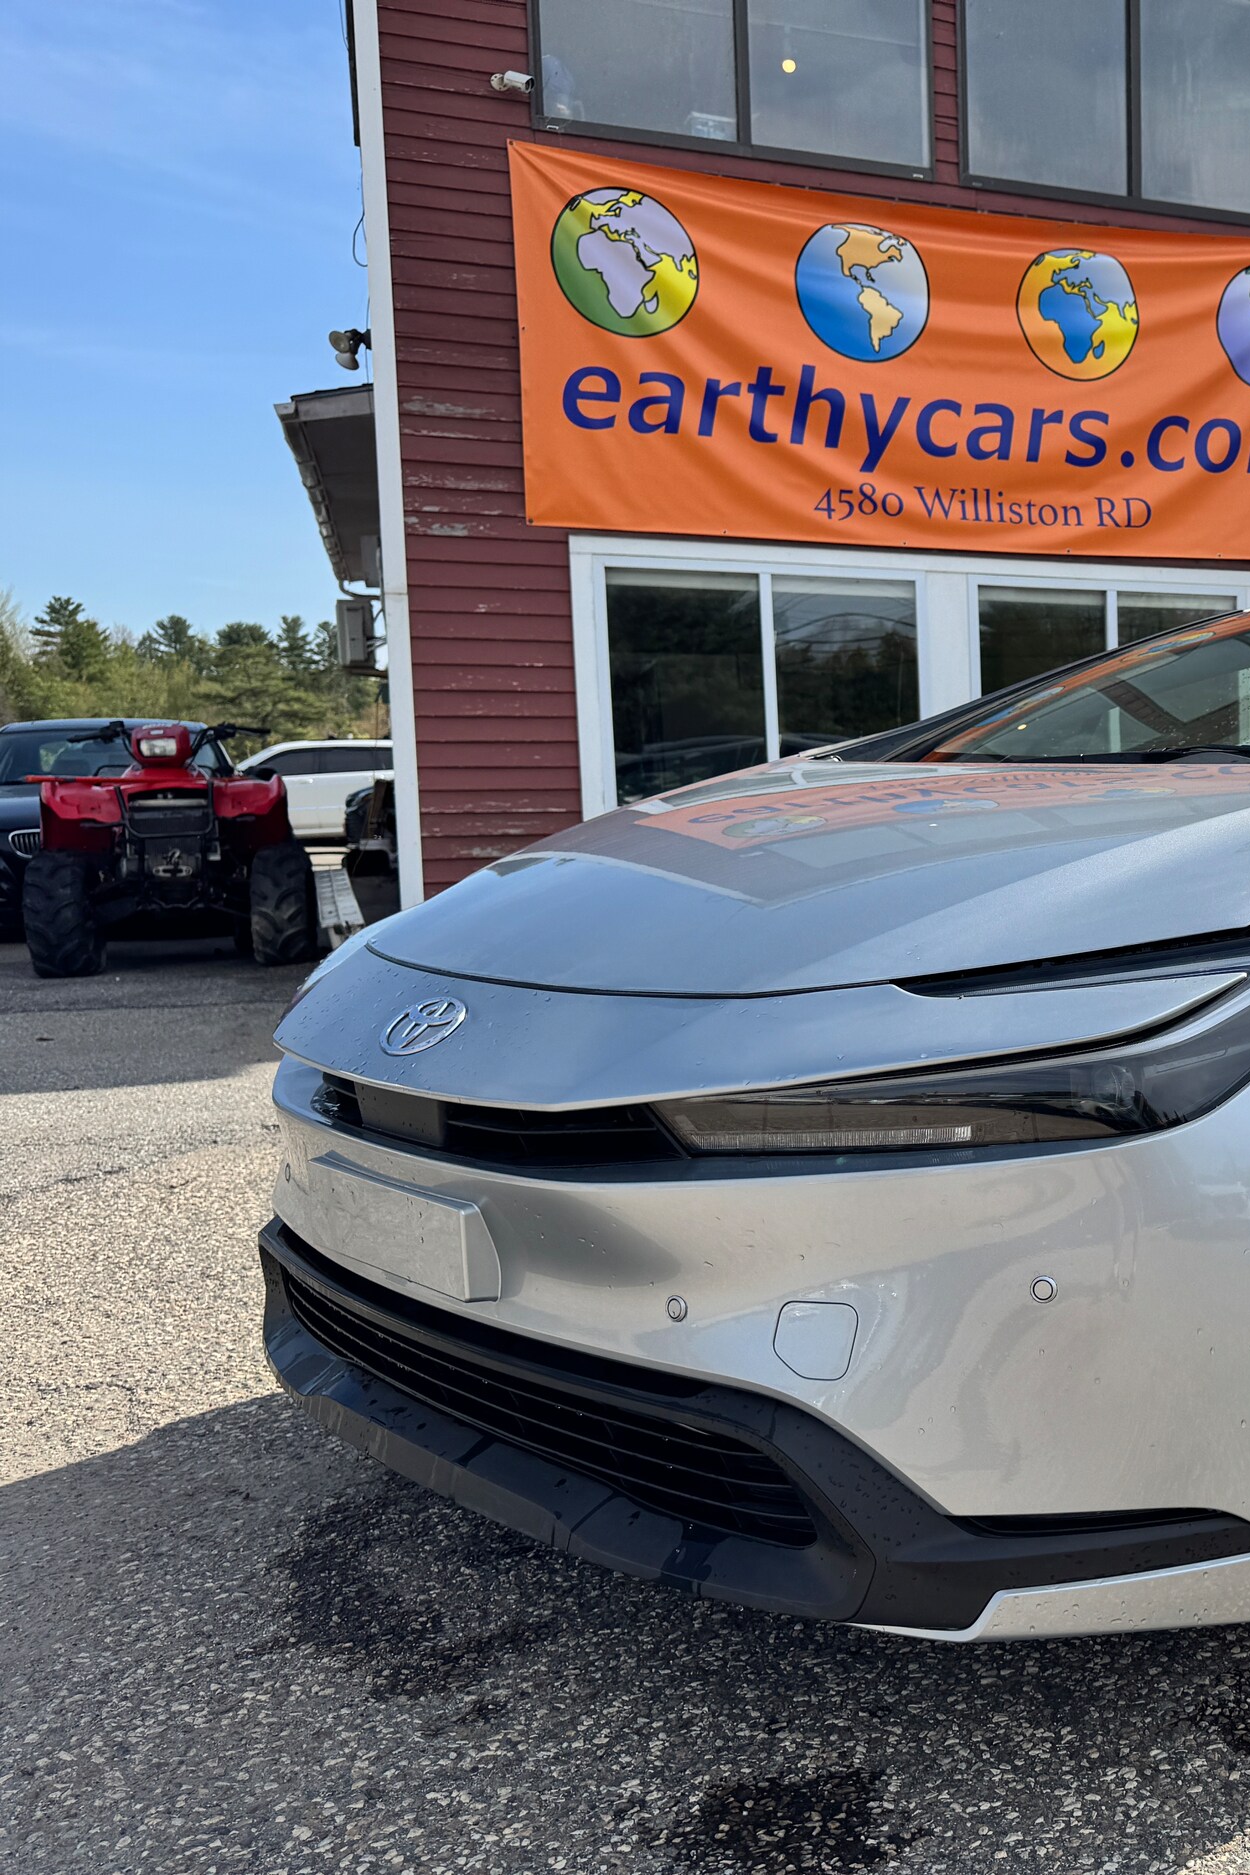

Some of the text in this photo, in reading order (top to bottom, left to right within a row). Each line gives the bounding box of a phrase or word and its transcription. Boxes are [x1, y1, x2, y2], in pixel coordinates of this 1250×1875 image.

[813, 482, 1152, 529] 4580 Williston RD
